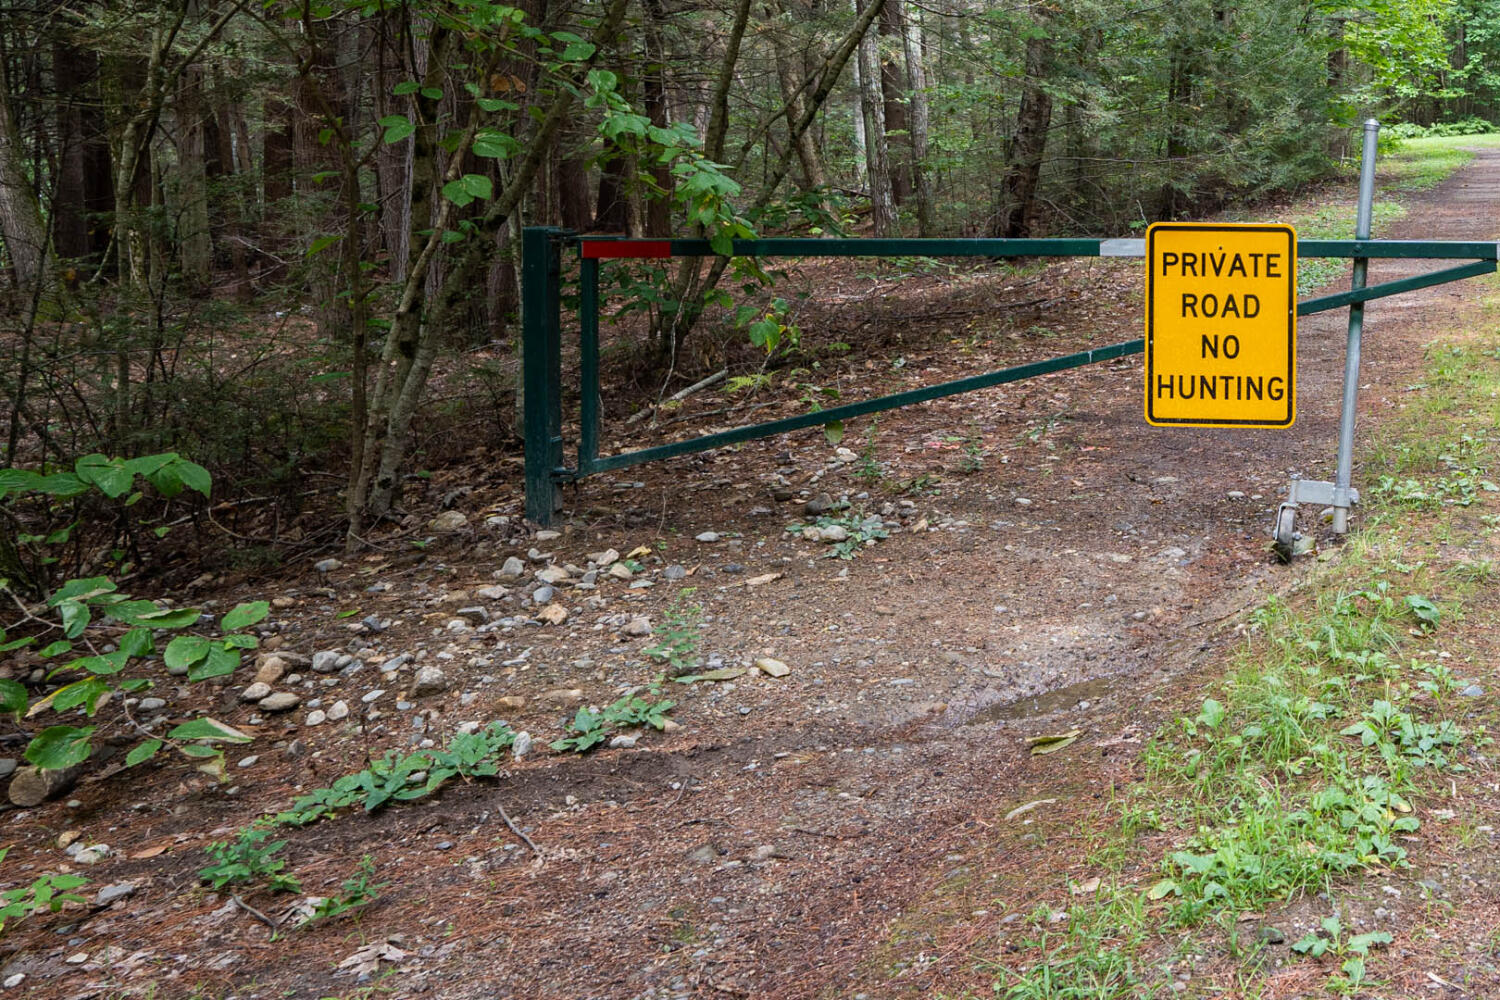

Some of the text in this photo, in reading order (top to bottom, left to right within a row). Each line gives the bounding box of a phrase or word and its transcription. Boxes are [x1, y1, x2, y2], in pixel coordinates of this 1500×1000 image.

[1162, 252, 1282, 278] PRIVATE
[1181, 293, 1260, 319] ROAD
[1201, 334, 1240, 360] NO
[1157, 374, 1284, 401] HUNTING
